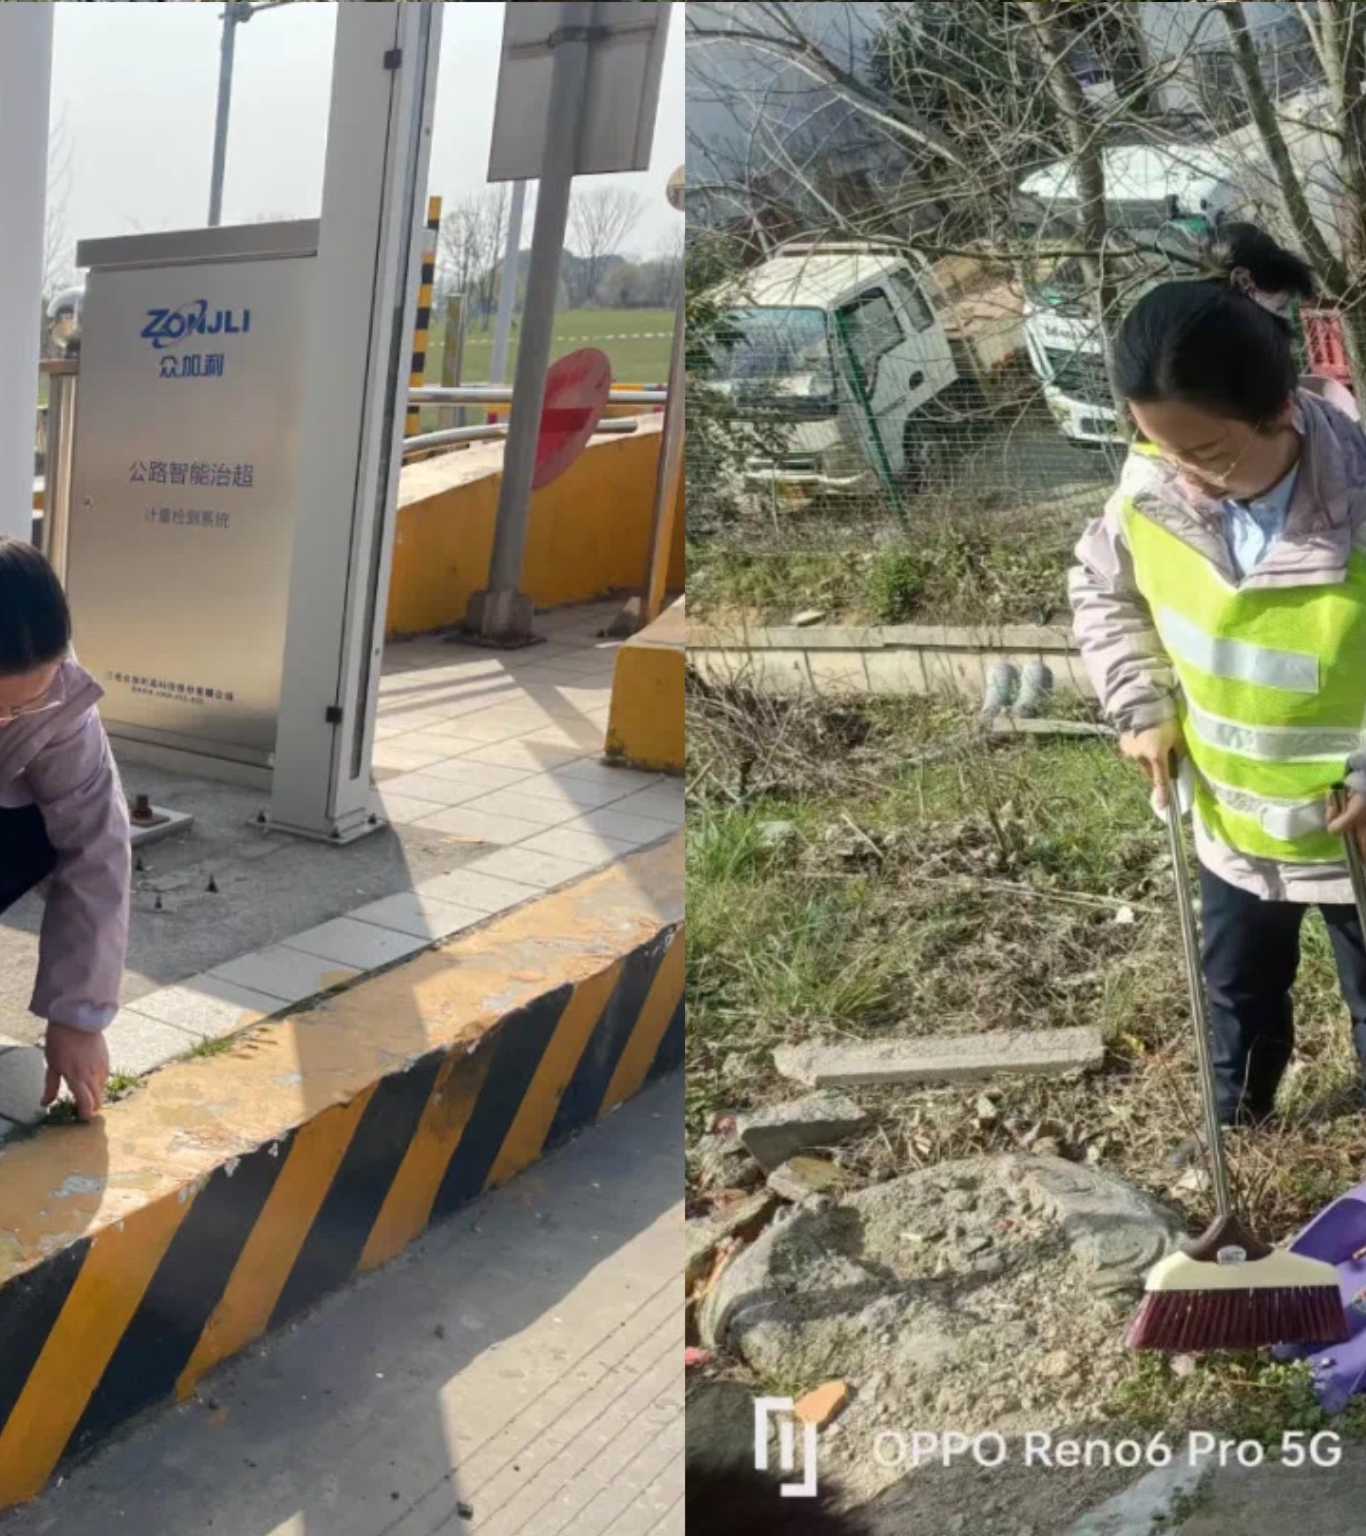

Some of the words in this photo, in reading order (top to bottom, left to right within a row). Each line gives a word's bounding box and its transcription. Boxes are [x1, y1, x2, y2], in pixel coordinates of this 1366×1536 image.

[159, 353, 225, 378] 众加利
[129, 460, 254, 487] 公路智能治超
[145, 507, 231, 529] 计量检测系统
